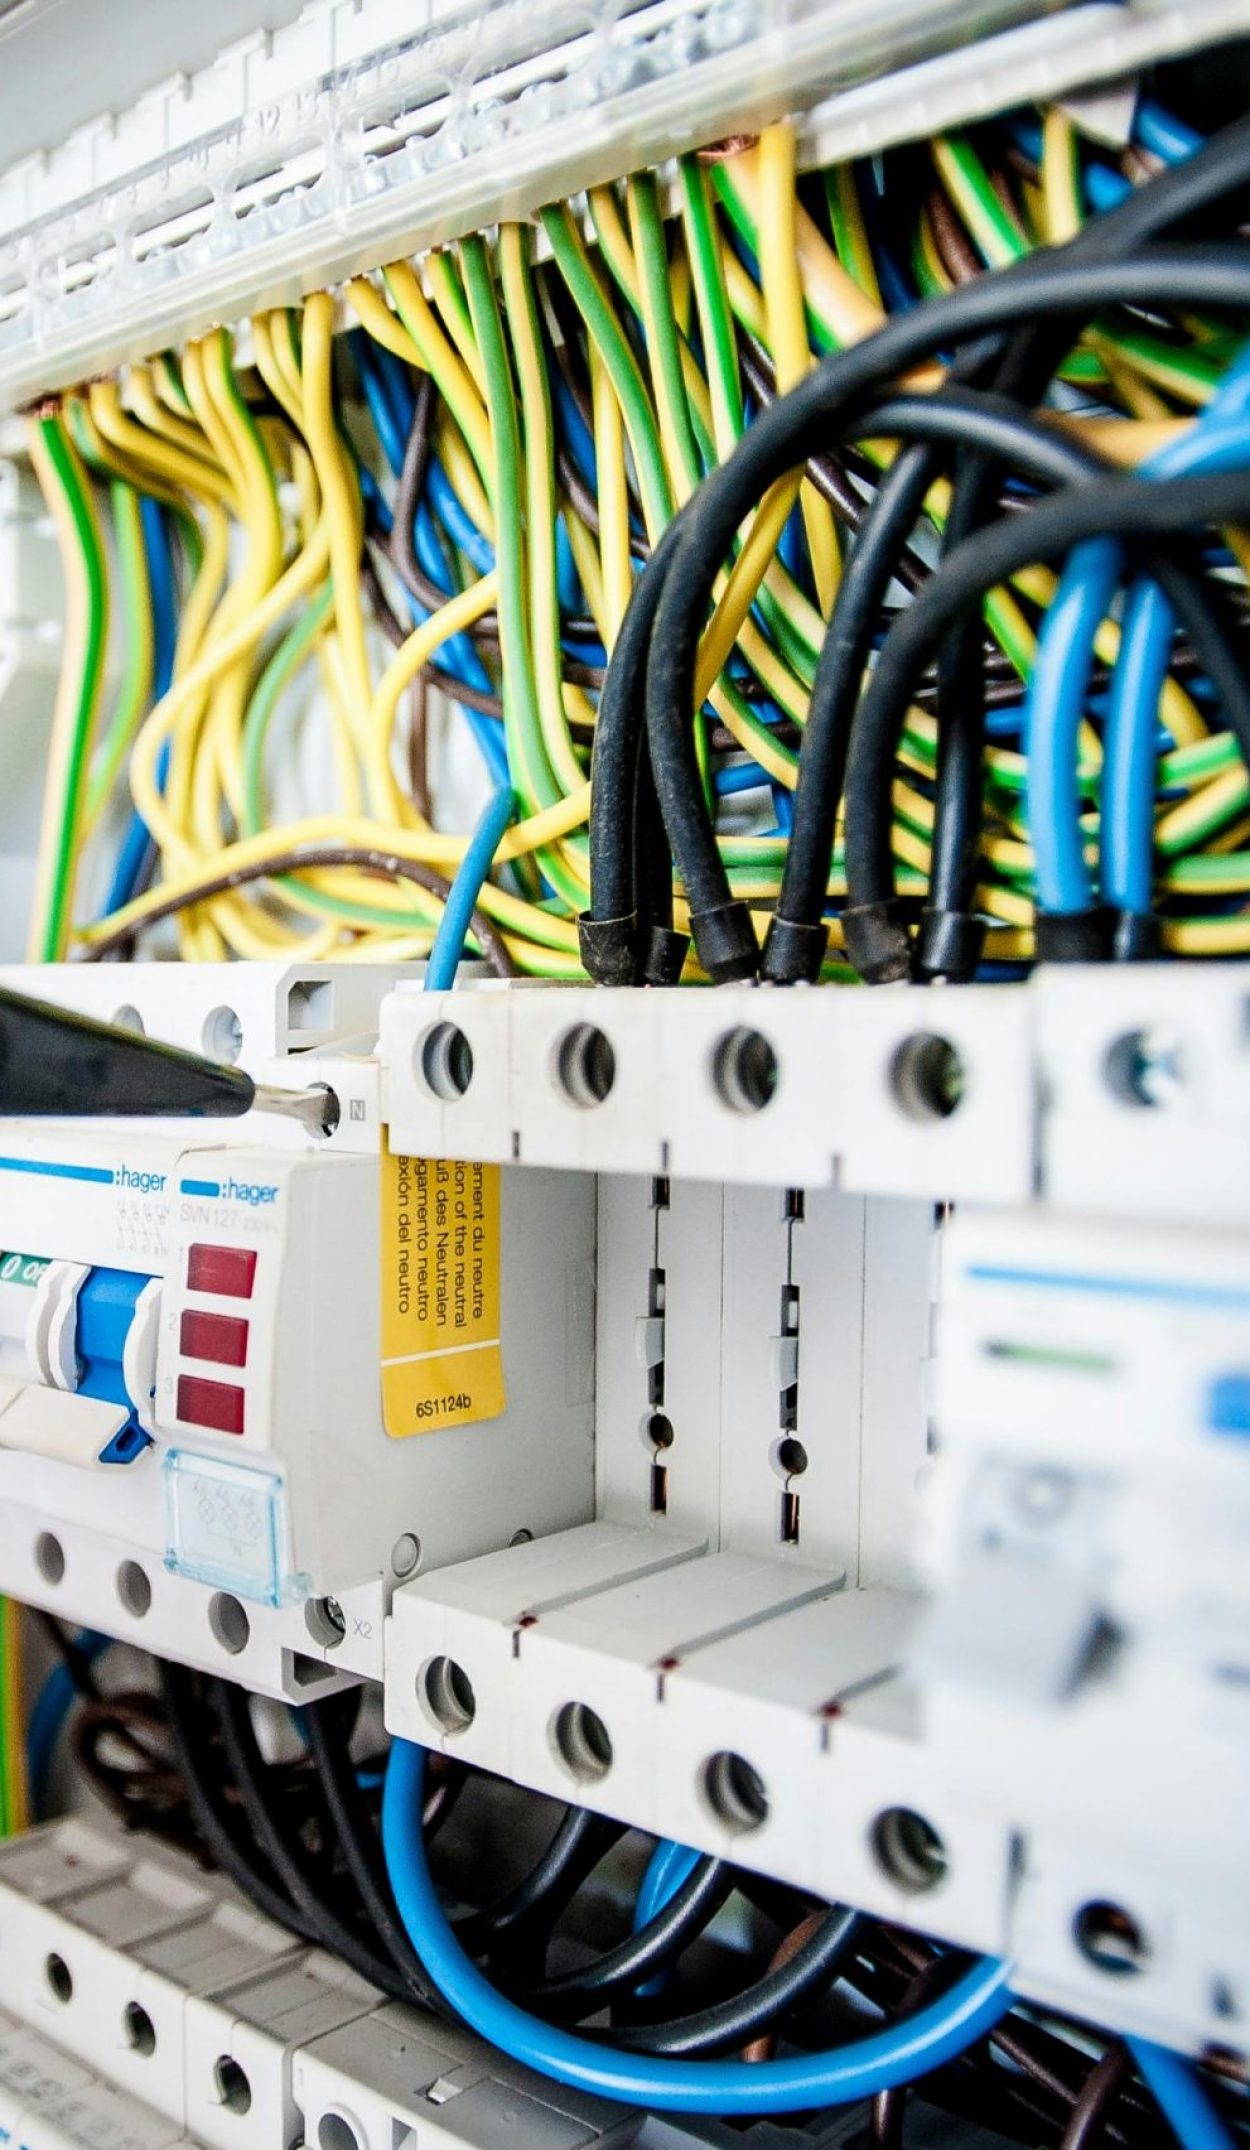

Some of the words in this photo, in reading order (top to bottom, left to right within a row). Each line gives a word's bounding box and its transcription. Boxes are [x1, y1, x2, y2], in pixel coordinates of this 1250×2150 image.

[350, 1100, 365, 1121] N
[180, 1202, 210, 1225] SVN
[214, 1208, 239, 1228] 127
[436, 1190, 449, 1226] des
[455, 1201, 467, 1218] of
[398, 1213, 411, 1243] del
[455, 1226, 467, 1256] the
[472, 1227, 485, 1251] du
[398, 1250, 411, 1314] neutro
[417, 1257, 429, 1321] neutro
[436, 1232, 449, 1326] Neutralen
[472, 1258, 484, 1319] neutre
[455, 1263, 467, 1328] neutral
[168, 1312, 178, 1332] 2
[164, 1376, 174, 1395] 3
[415, 1393, 472, 1418] 6S1124b
[353, 1616, 372, 1640] X2
